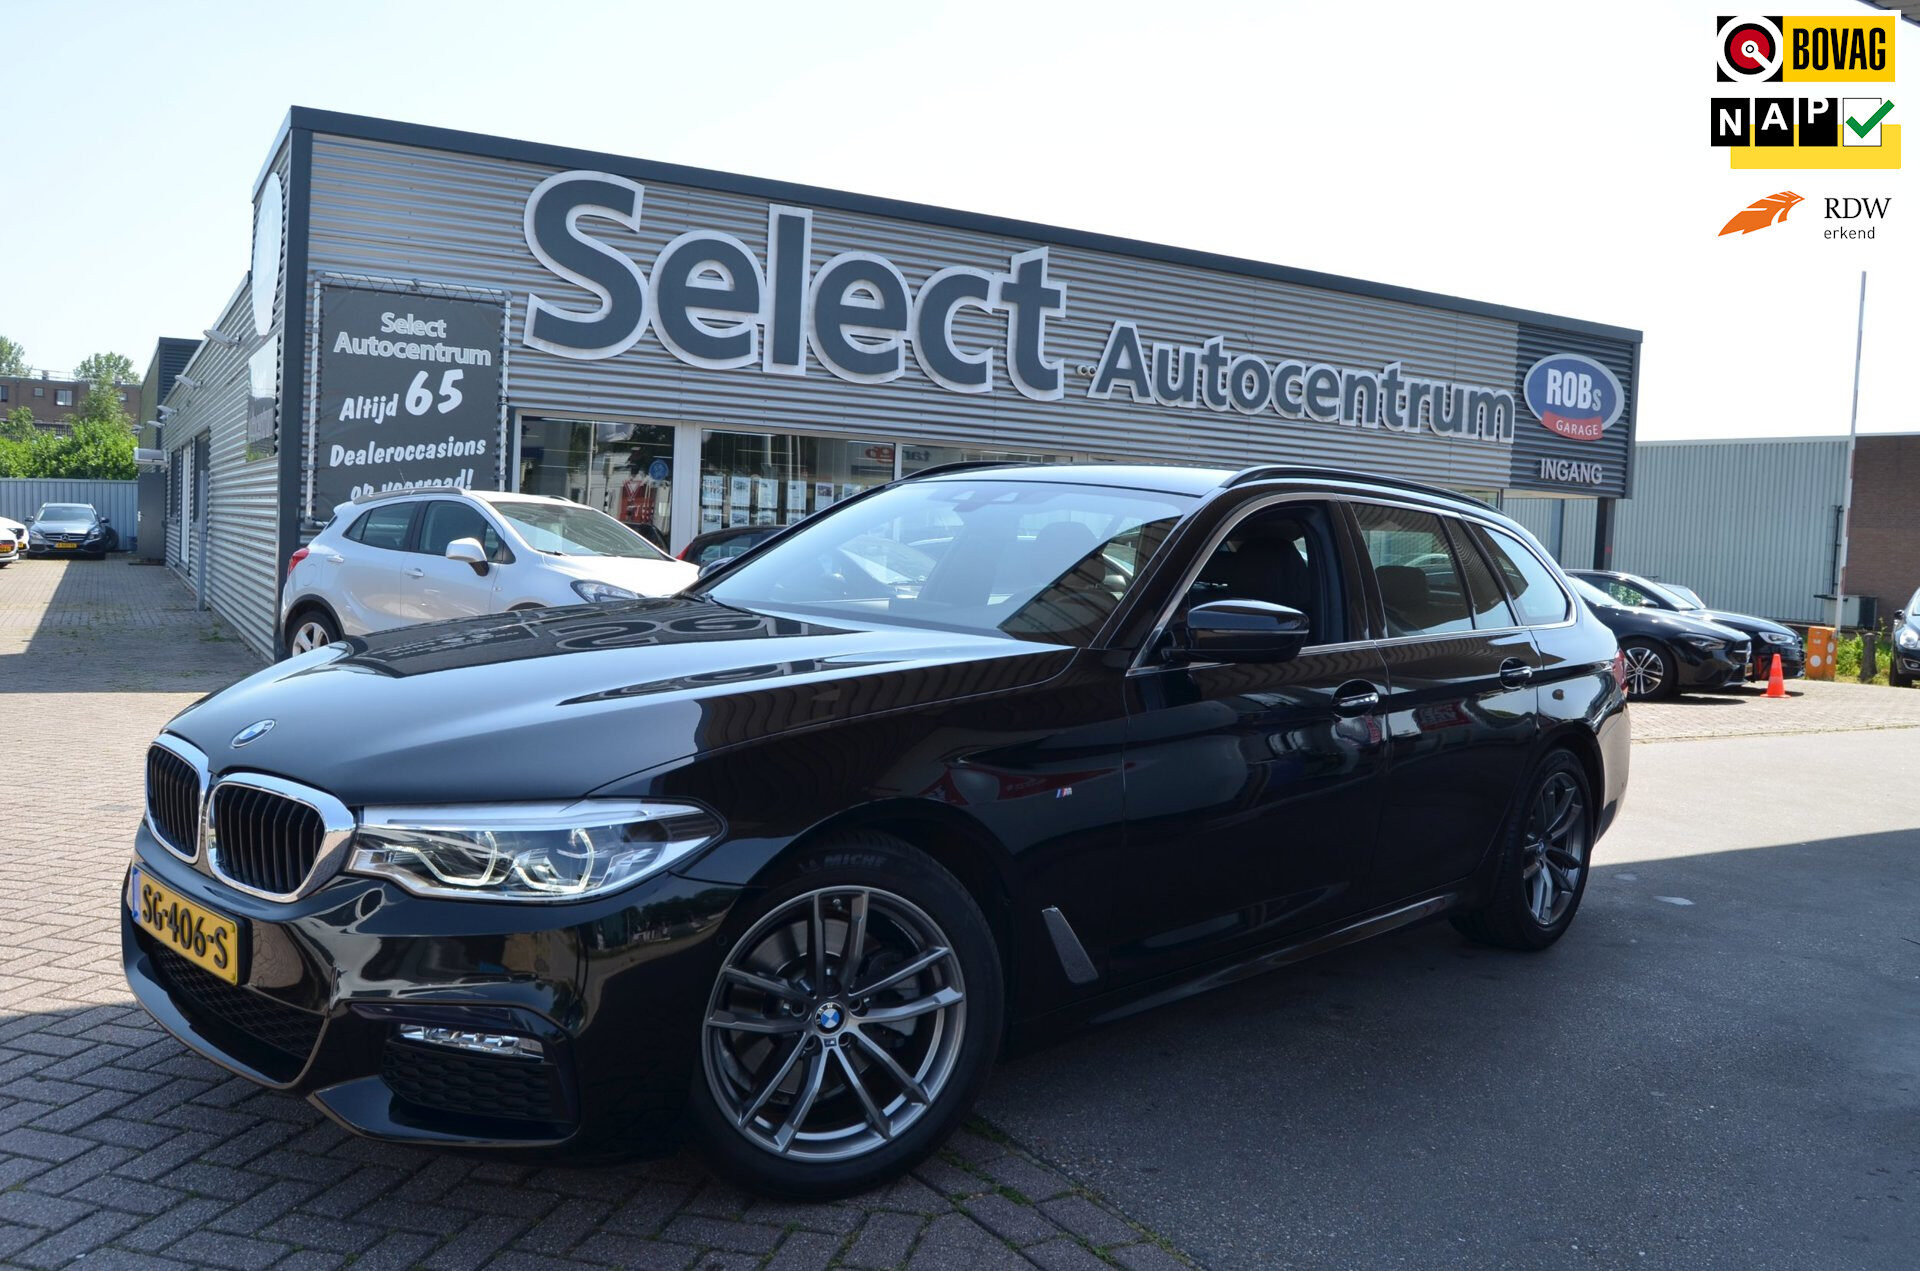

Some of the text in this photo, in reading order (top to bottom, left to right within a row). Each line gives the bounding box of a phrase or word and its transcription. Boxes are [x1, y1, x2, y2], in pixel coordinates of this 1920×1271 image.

[380, 311, 447, 338] Select
[523, 170, 1515, 443] Select Autocentrum
[333, 331, 492, 367] Autocentrum
[339, 369, 464, 425] Altijd 65
[1545, 368, 1602, 412] ROBs
[1556, 420, 1599, 435] GARAGE
[329, 436, 487, 467] Dealeroccasions
[1540, 458, 1603, 484] INGANG
[142, 884, 228, 969] SG-406-S
